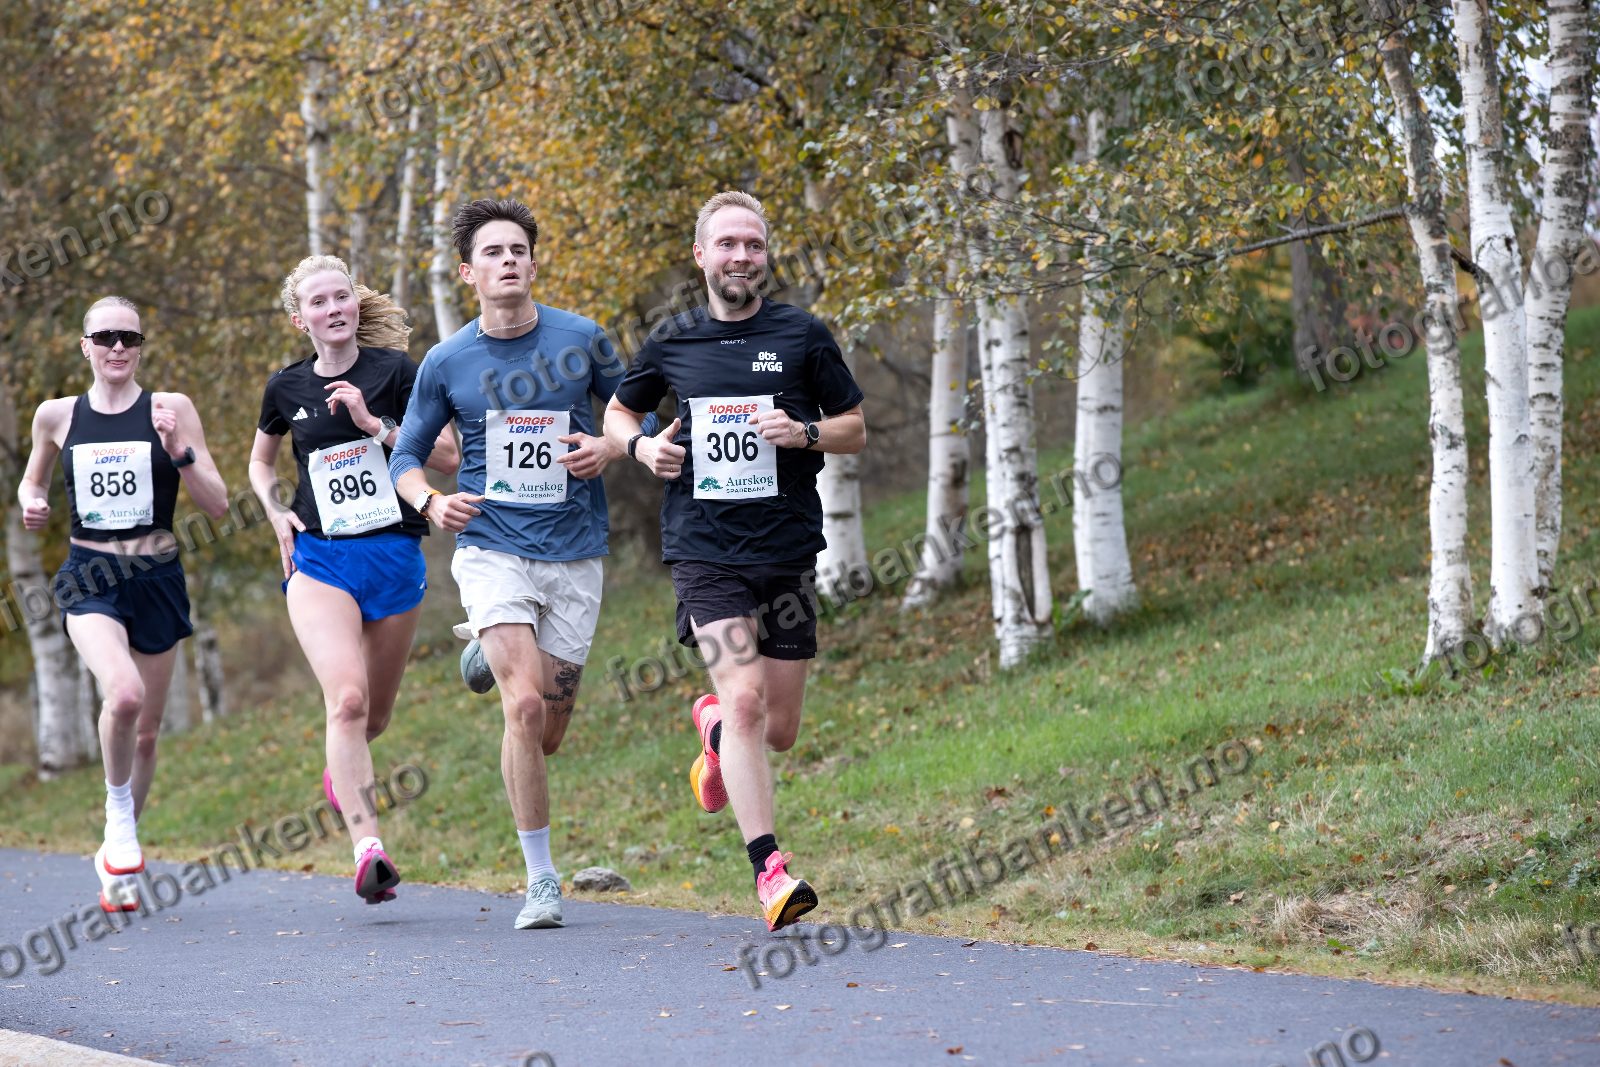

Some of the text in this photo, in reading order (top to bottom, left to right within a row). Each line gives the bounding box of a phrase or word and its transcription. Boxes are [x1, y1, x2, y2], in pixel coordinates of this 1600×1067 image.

[752, 361, 783, 372] BYGG
[709, 404, 758, 414] NORGES
[504, 416, 554, 425] NORGES
[712, 413, 751, 424] LØPET
[508, 425, 546, 434] LØPET
[91, 447, 136, 457] NORGES
[707, 431, 759, 462] 306
[95, 455, 129, 464] LØPET
[323, 445, 368, 464] NORGES
[503, 441, 552, 469] 126
[330, 455, 362, 471] LØPET
[90, 470, 137, 497] 858
[726, 474, 774, 486] Aurskog
[329, 470, 377, 504] 896
[518, 482, 564, 493] Aurskog
[109, 507, 151, 518] Aurskog
[355, 506, 398, 522] Aurskog
